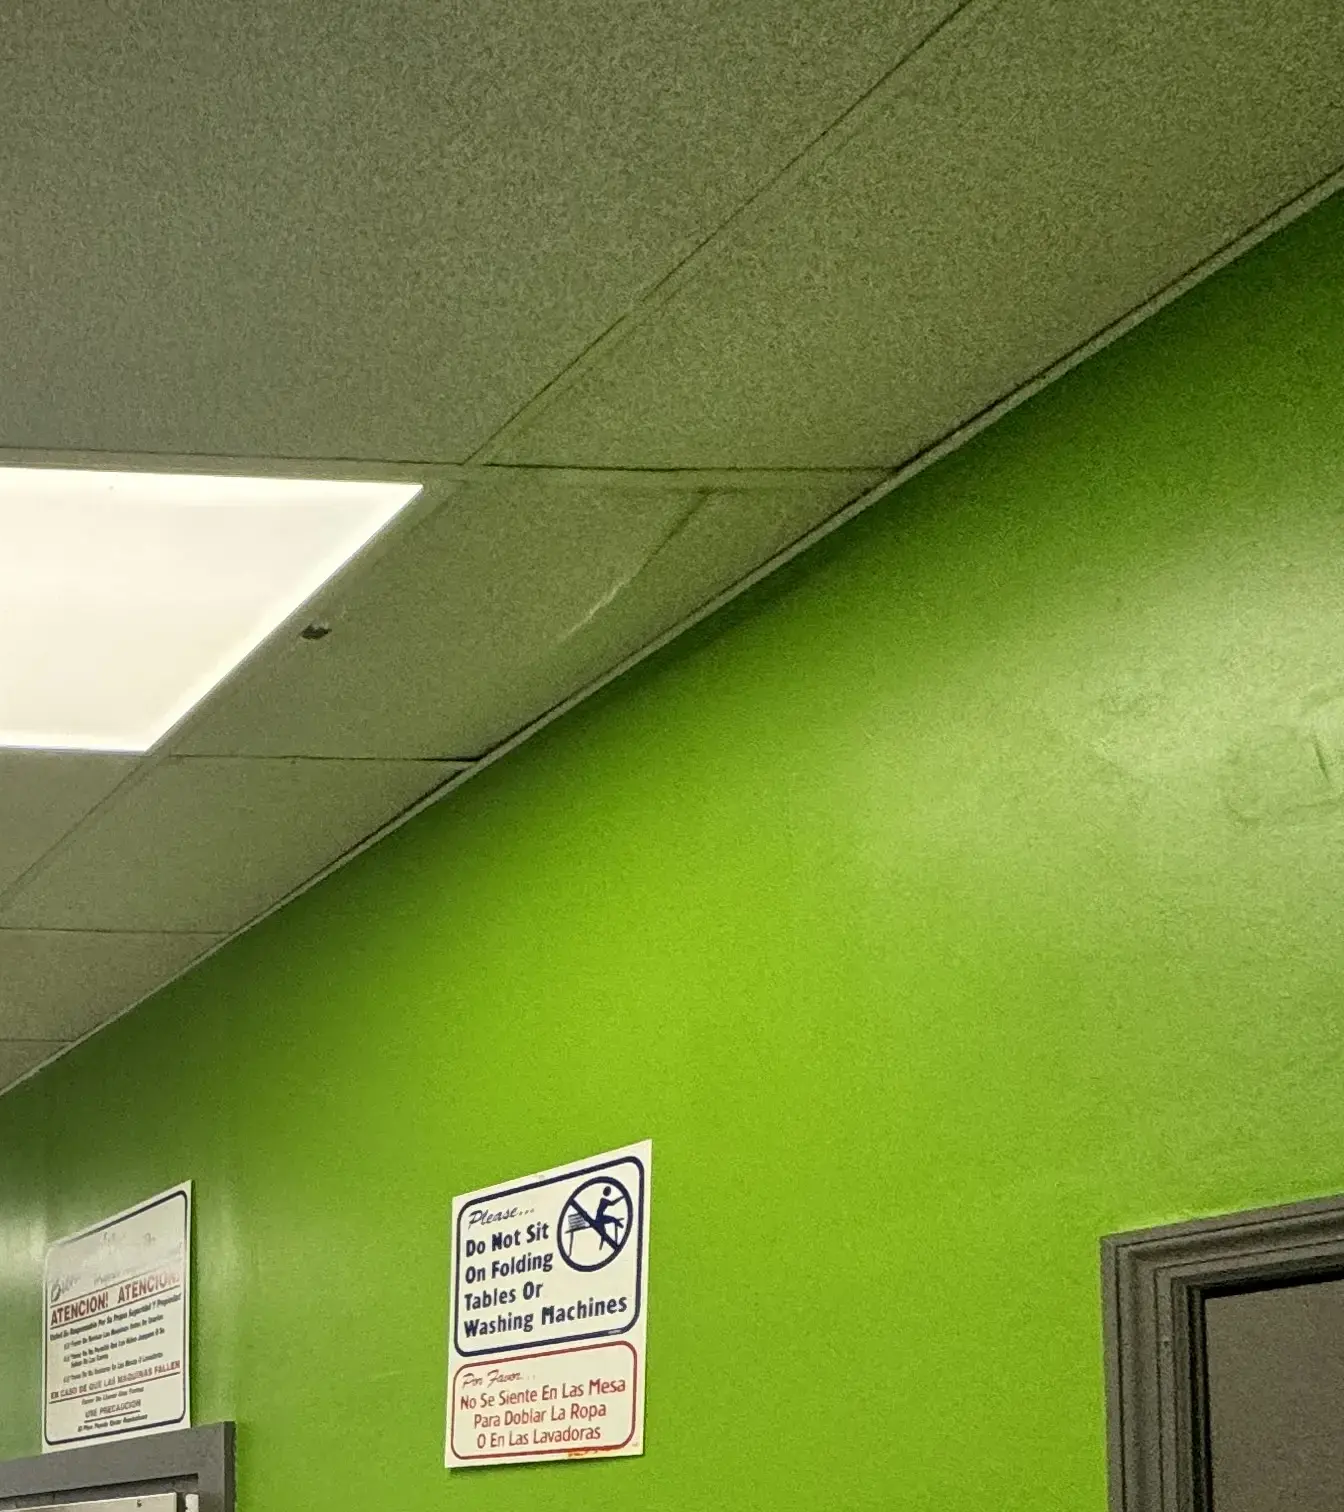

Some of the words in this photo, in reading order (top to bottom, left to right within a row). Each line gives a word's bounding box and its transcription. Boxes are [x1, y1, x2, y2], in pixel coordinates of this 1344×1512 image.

[466, 1239, 486, 1258] Do
[492, 1229, 521, 1252] Not
[527, 1221, 549, 1244] Sit
[465, 1266, 486, 1284] On
[491, 1252, 553, 1279] Folding
[51, 1291, 109, 1326] ATENCION!
[464, 1288, 516, 1311] Tables
[523, 1281, 544, 1301] Or
[464, 1312, 534, 1338] Washing
[541, 1296, 628, 1325] Machines
[460, 1395, 477, 1411] No
[480, 1393, 495, 1408] Se
[499, 1389, 537, 1406] Siente
[542, 1385, 558, 1400] En
[562, 1382, 584, 1399] Las
[588, 1378, 626, 1396] Mesa
[474, 1414, 500, 1429] Para
[504, 1408, 547, 1426] Doblar
[551, 1405, 565, 1421] La
[570, 1403, 607, 1421] Ropa
[477, 1434, 486, 1449] O
[490, 1432, 505, 1448] En
[509, 1430, 529, 1446] Las
[533, 1425, 601, 1444] Lavadoras
